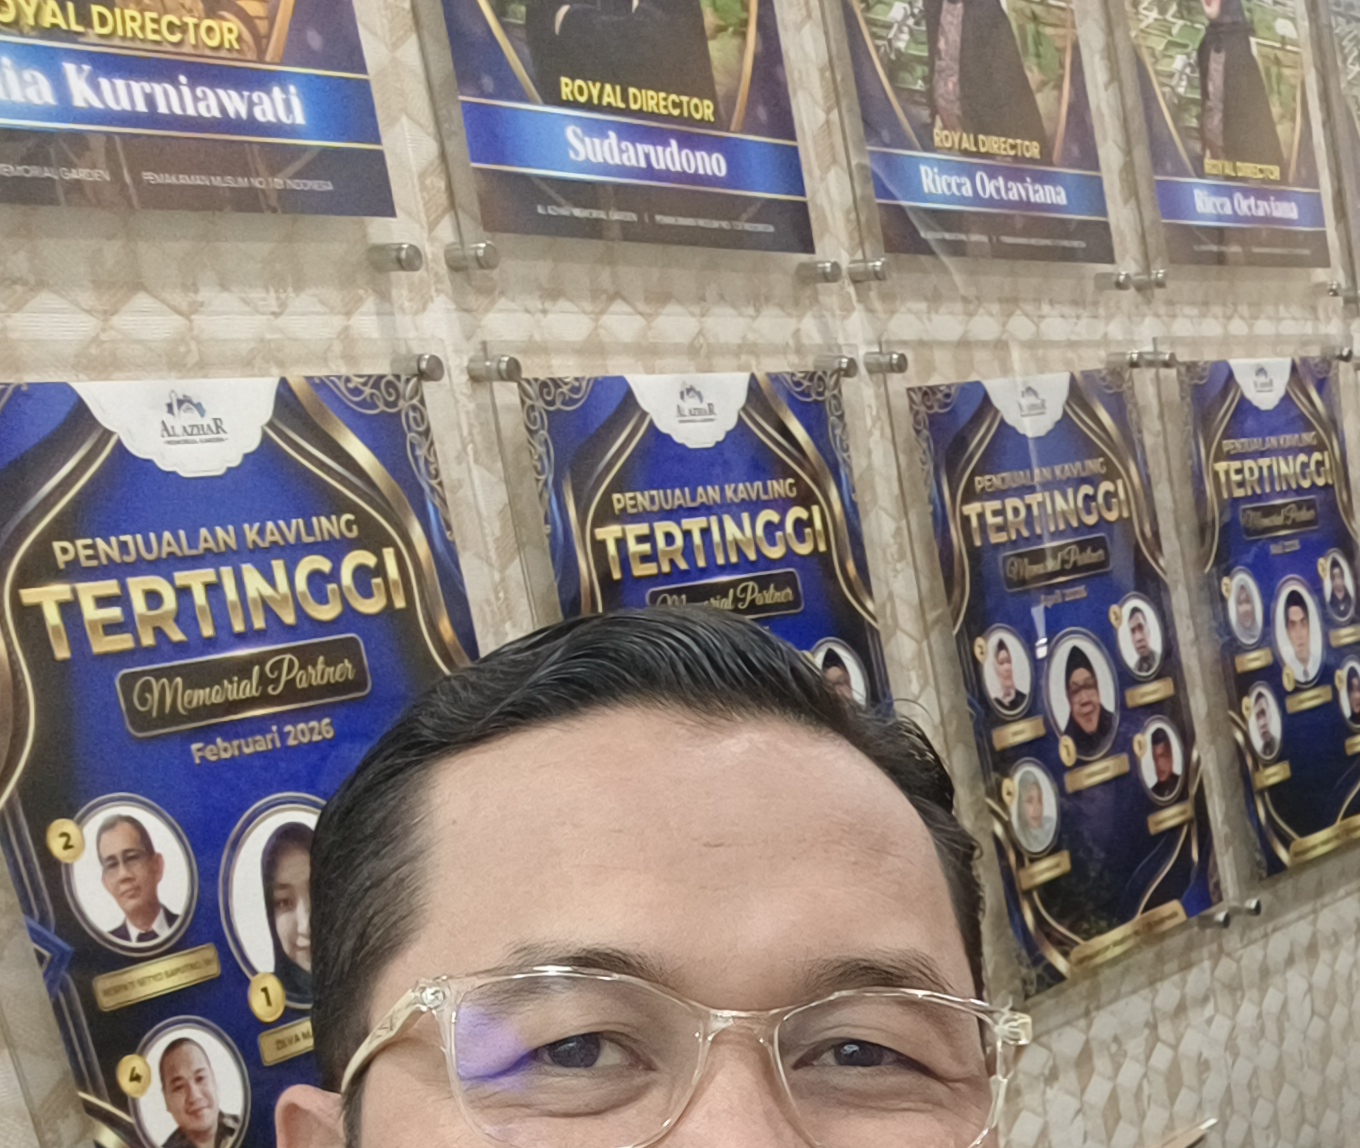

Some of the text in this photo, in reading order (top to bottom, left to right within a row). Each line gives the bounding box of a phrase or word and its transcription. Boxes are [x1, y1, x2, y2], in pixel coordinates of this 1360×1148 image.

[91, 6, 241, 50] DIRECTOR
[62, 62, 306, 126] Kurniawati
[560, 76, 715, 122] ROYAL DIRECTOR
[565, 125, 727, 177] Sudarudono
[933, 129, 1041, 159] ROYAL DIRECTOR
[919, 164, 1068, 205] Ricca Octaviana
[161, 417, 228, 437] AL AZHAR
[612, 478, 798, 515] PENJUALAN KAVLING
[974, 457, 1107, 495] PENJUALAN KAVLING
[1213, 450, 1334, 499] TERTINGGI
[961, 478, 1131, 547] TERTINGGI
[52, 512, 359, 570] PENJUALAN KAVLING
[594, 504, 828, 581] TERTINGGI
[18, 546, 408, 662] TERTINGGI
[736, 581, 794, 609] Partner
[133, 653, 356, 717] Memorial Partner
[190, 717, 335, 764] Februari 2026
[61, 831, 75, 851] 2
[260, 986, 272, 1008] 1
[128, 1066, 143, 1084] 4
